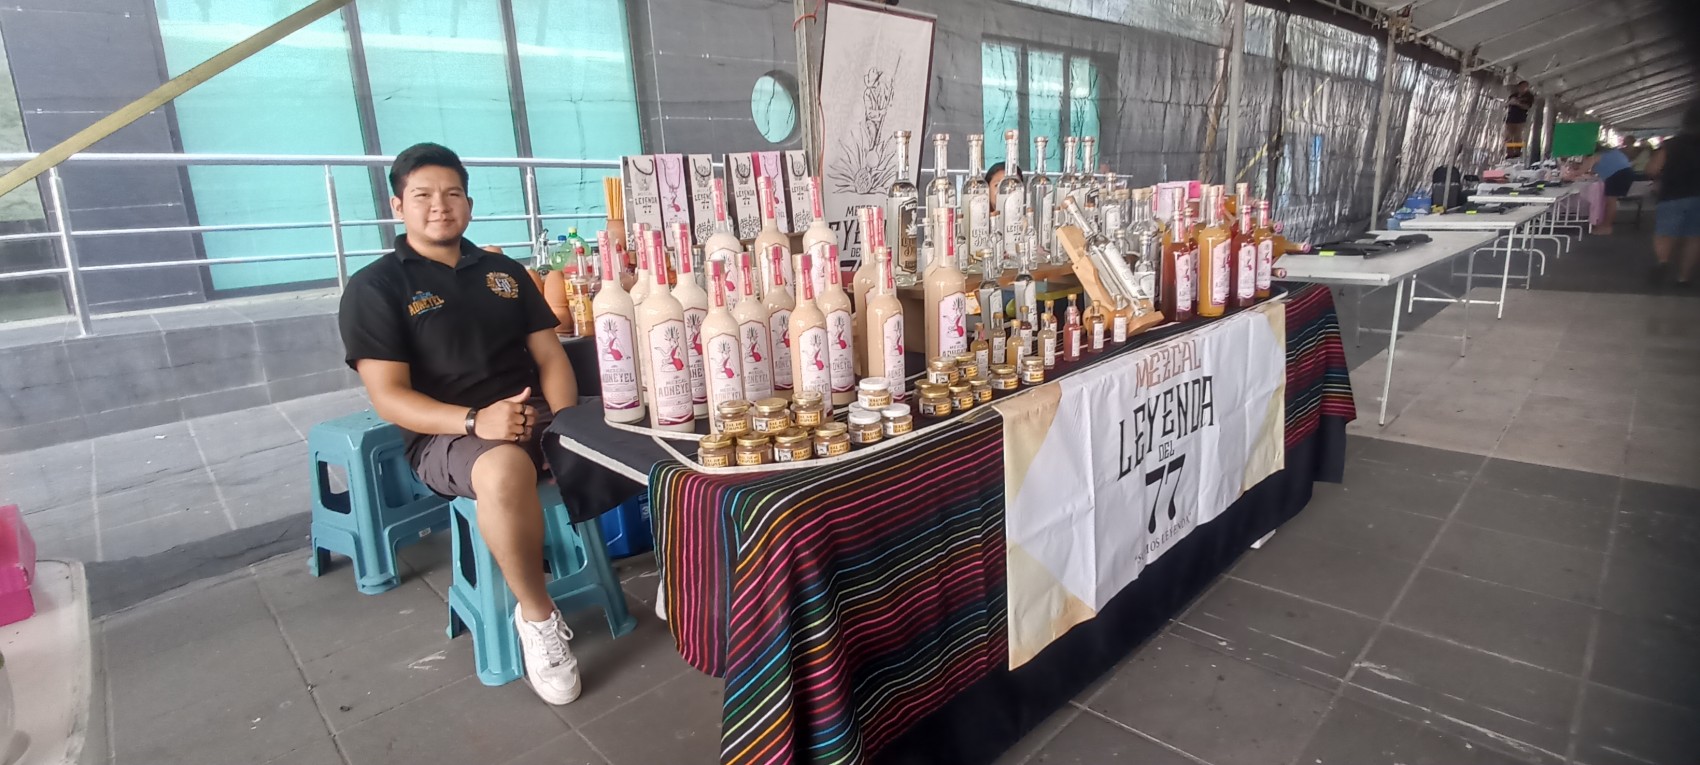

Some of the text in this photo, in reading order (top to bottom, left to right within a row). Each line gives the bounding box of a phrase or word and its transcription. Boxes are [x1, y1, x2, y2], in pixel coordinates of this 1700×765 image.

[658, 382, 689, 397] ADNEYE
[1134, 340, 1202, 399] MEZCAL
[1117, 376, 1214, 481] LEYENDA
[1158, 440, 1175, 462] DEL
[1145, 453, 1186, 534] 77
